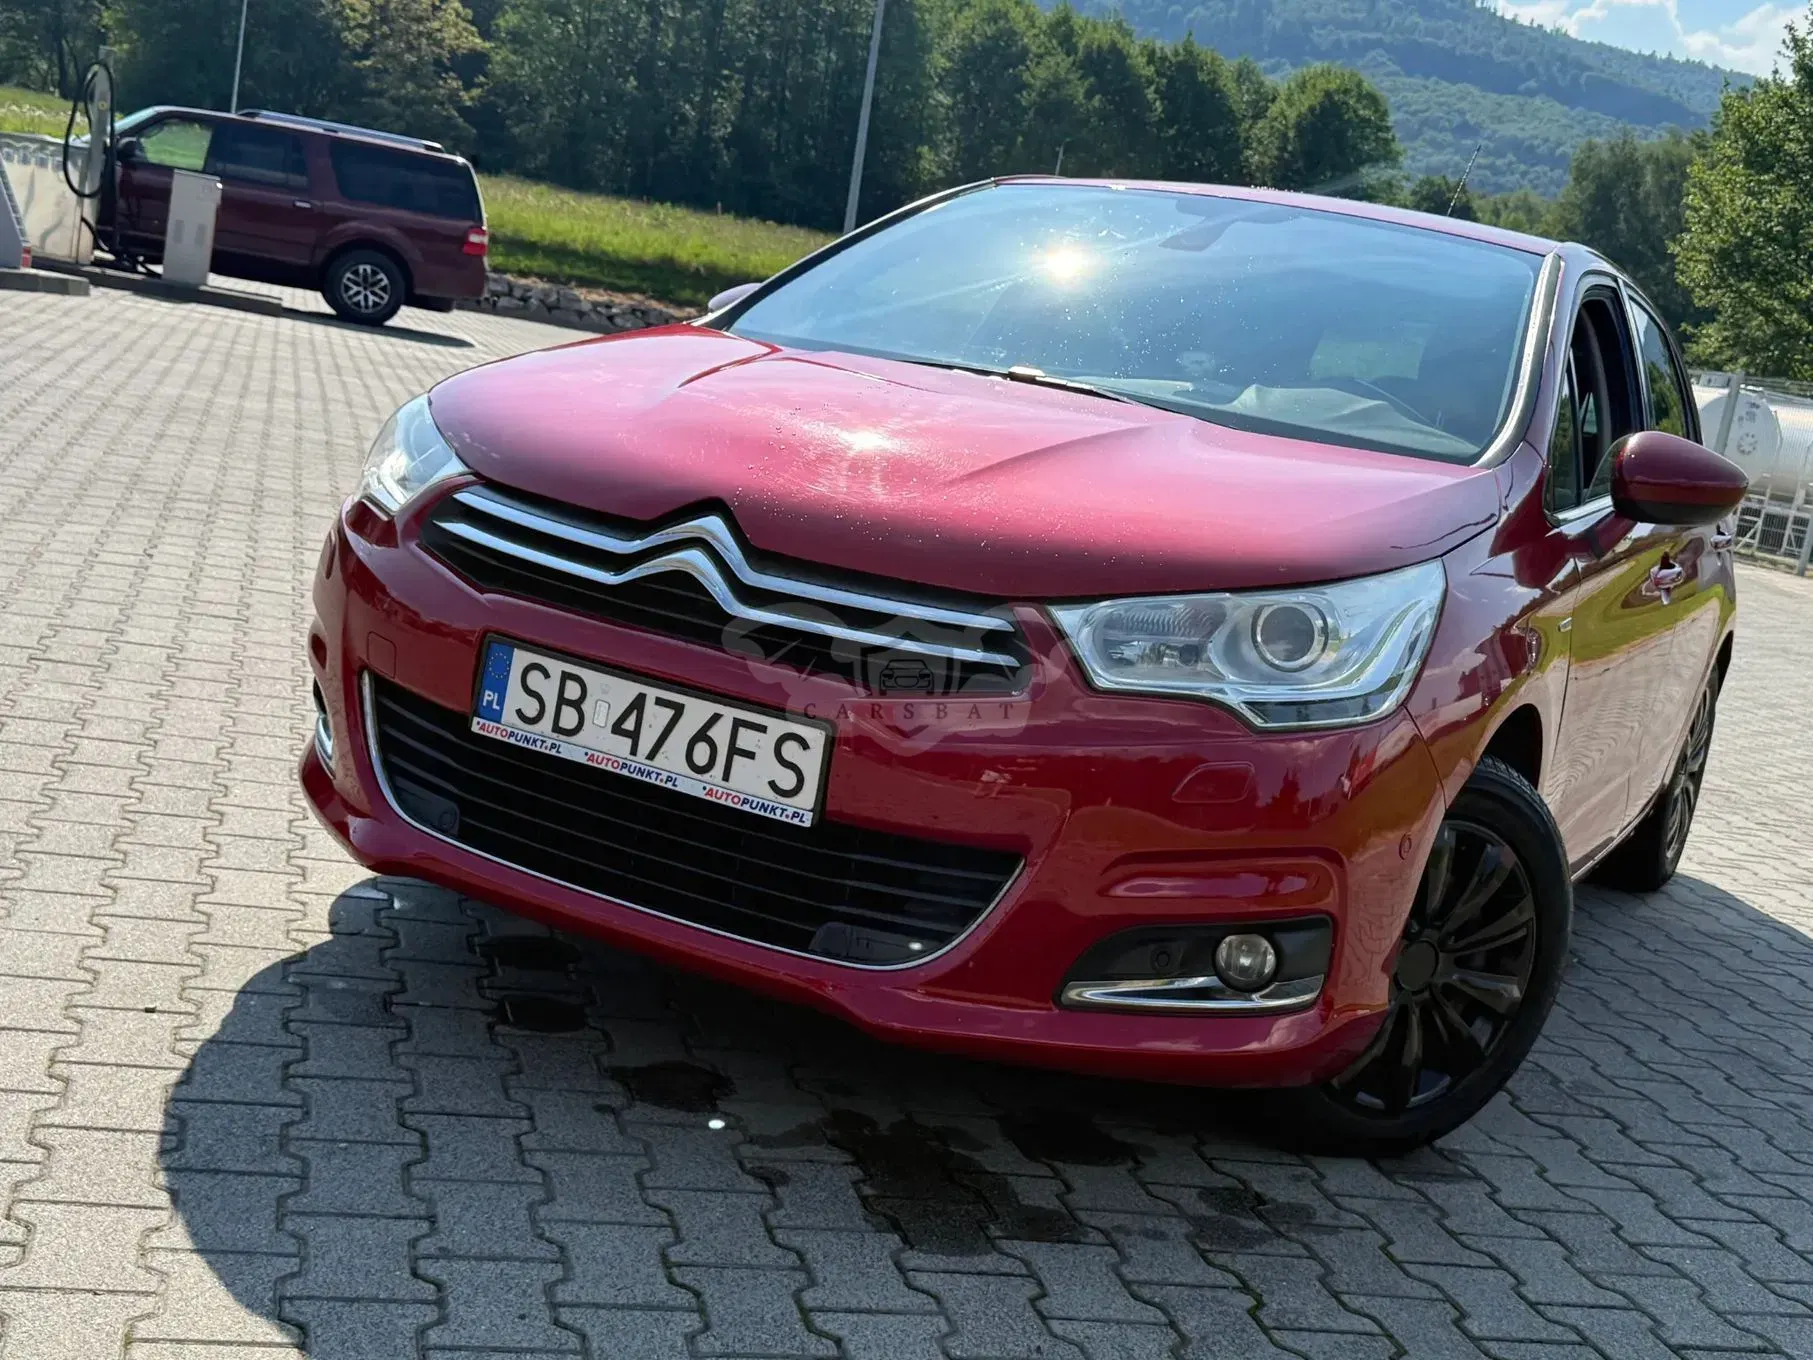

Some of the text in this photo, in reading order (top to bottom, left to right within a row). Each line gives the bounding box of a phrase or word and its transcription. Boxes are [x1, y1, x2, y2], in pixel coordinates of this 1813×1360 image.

[482, 689, 501, 710] PL
[479, 722, 562, 754] AUTOPUNKT.PL
[515, 662, 811, 799] SB 476FS
[586, 752, 678, 788] AUTOPUNKT.PL
[704, 787, 806, 824] AUTOPUNKT.PL
